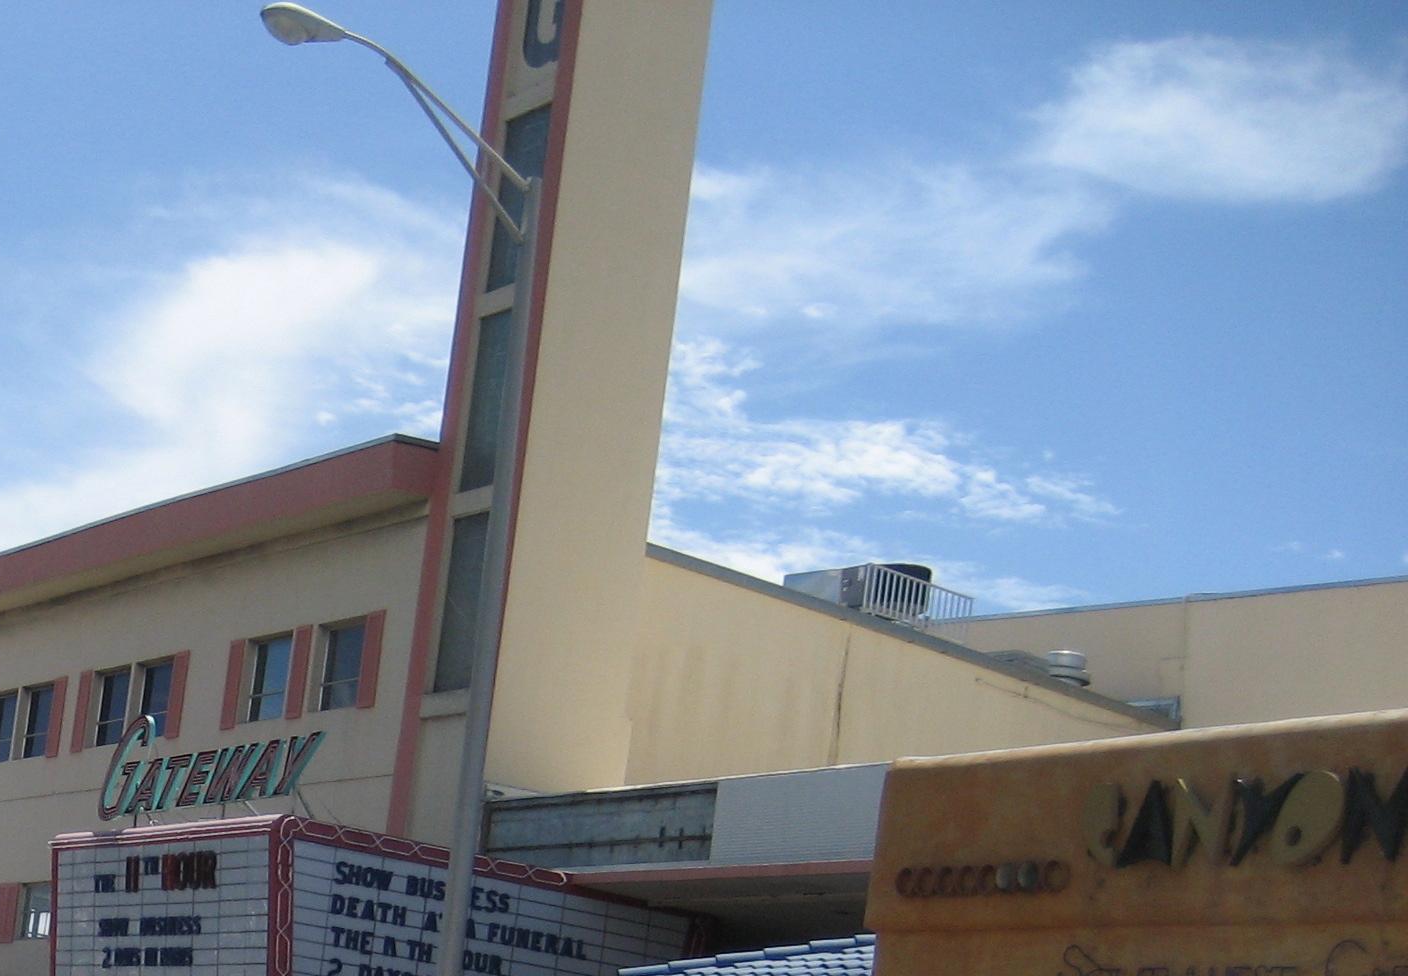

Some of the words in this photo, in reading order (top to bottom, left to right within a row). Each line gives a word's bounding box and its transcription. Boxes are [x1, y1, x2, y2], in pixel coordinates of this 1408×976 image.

[98, 714, 327, 821] GATEWAY
[160, 850, 217, 891] HOUR
[334, 861, 394, 891] SHOW
[405, 875, 511, 914] BUSESS
[330, 893, 408, 926] DEATH
[424, 910, 444, 933] A
[487, 922, 587, 961] FUNERAL
[331, 926, 375, 956] THE
